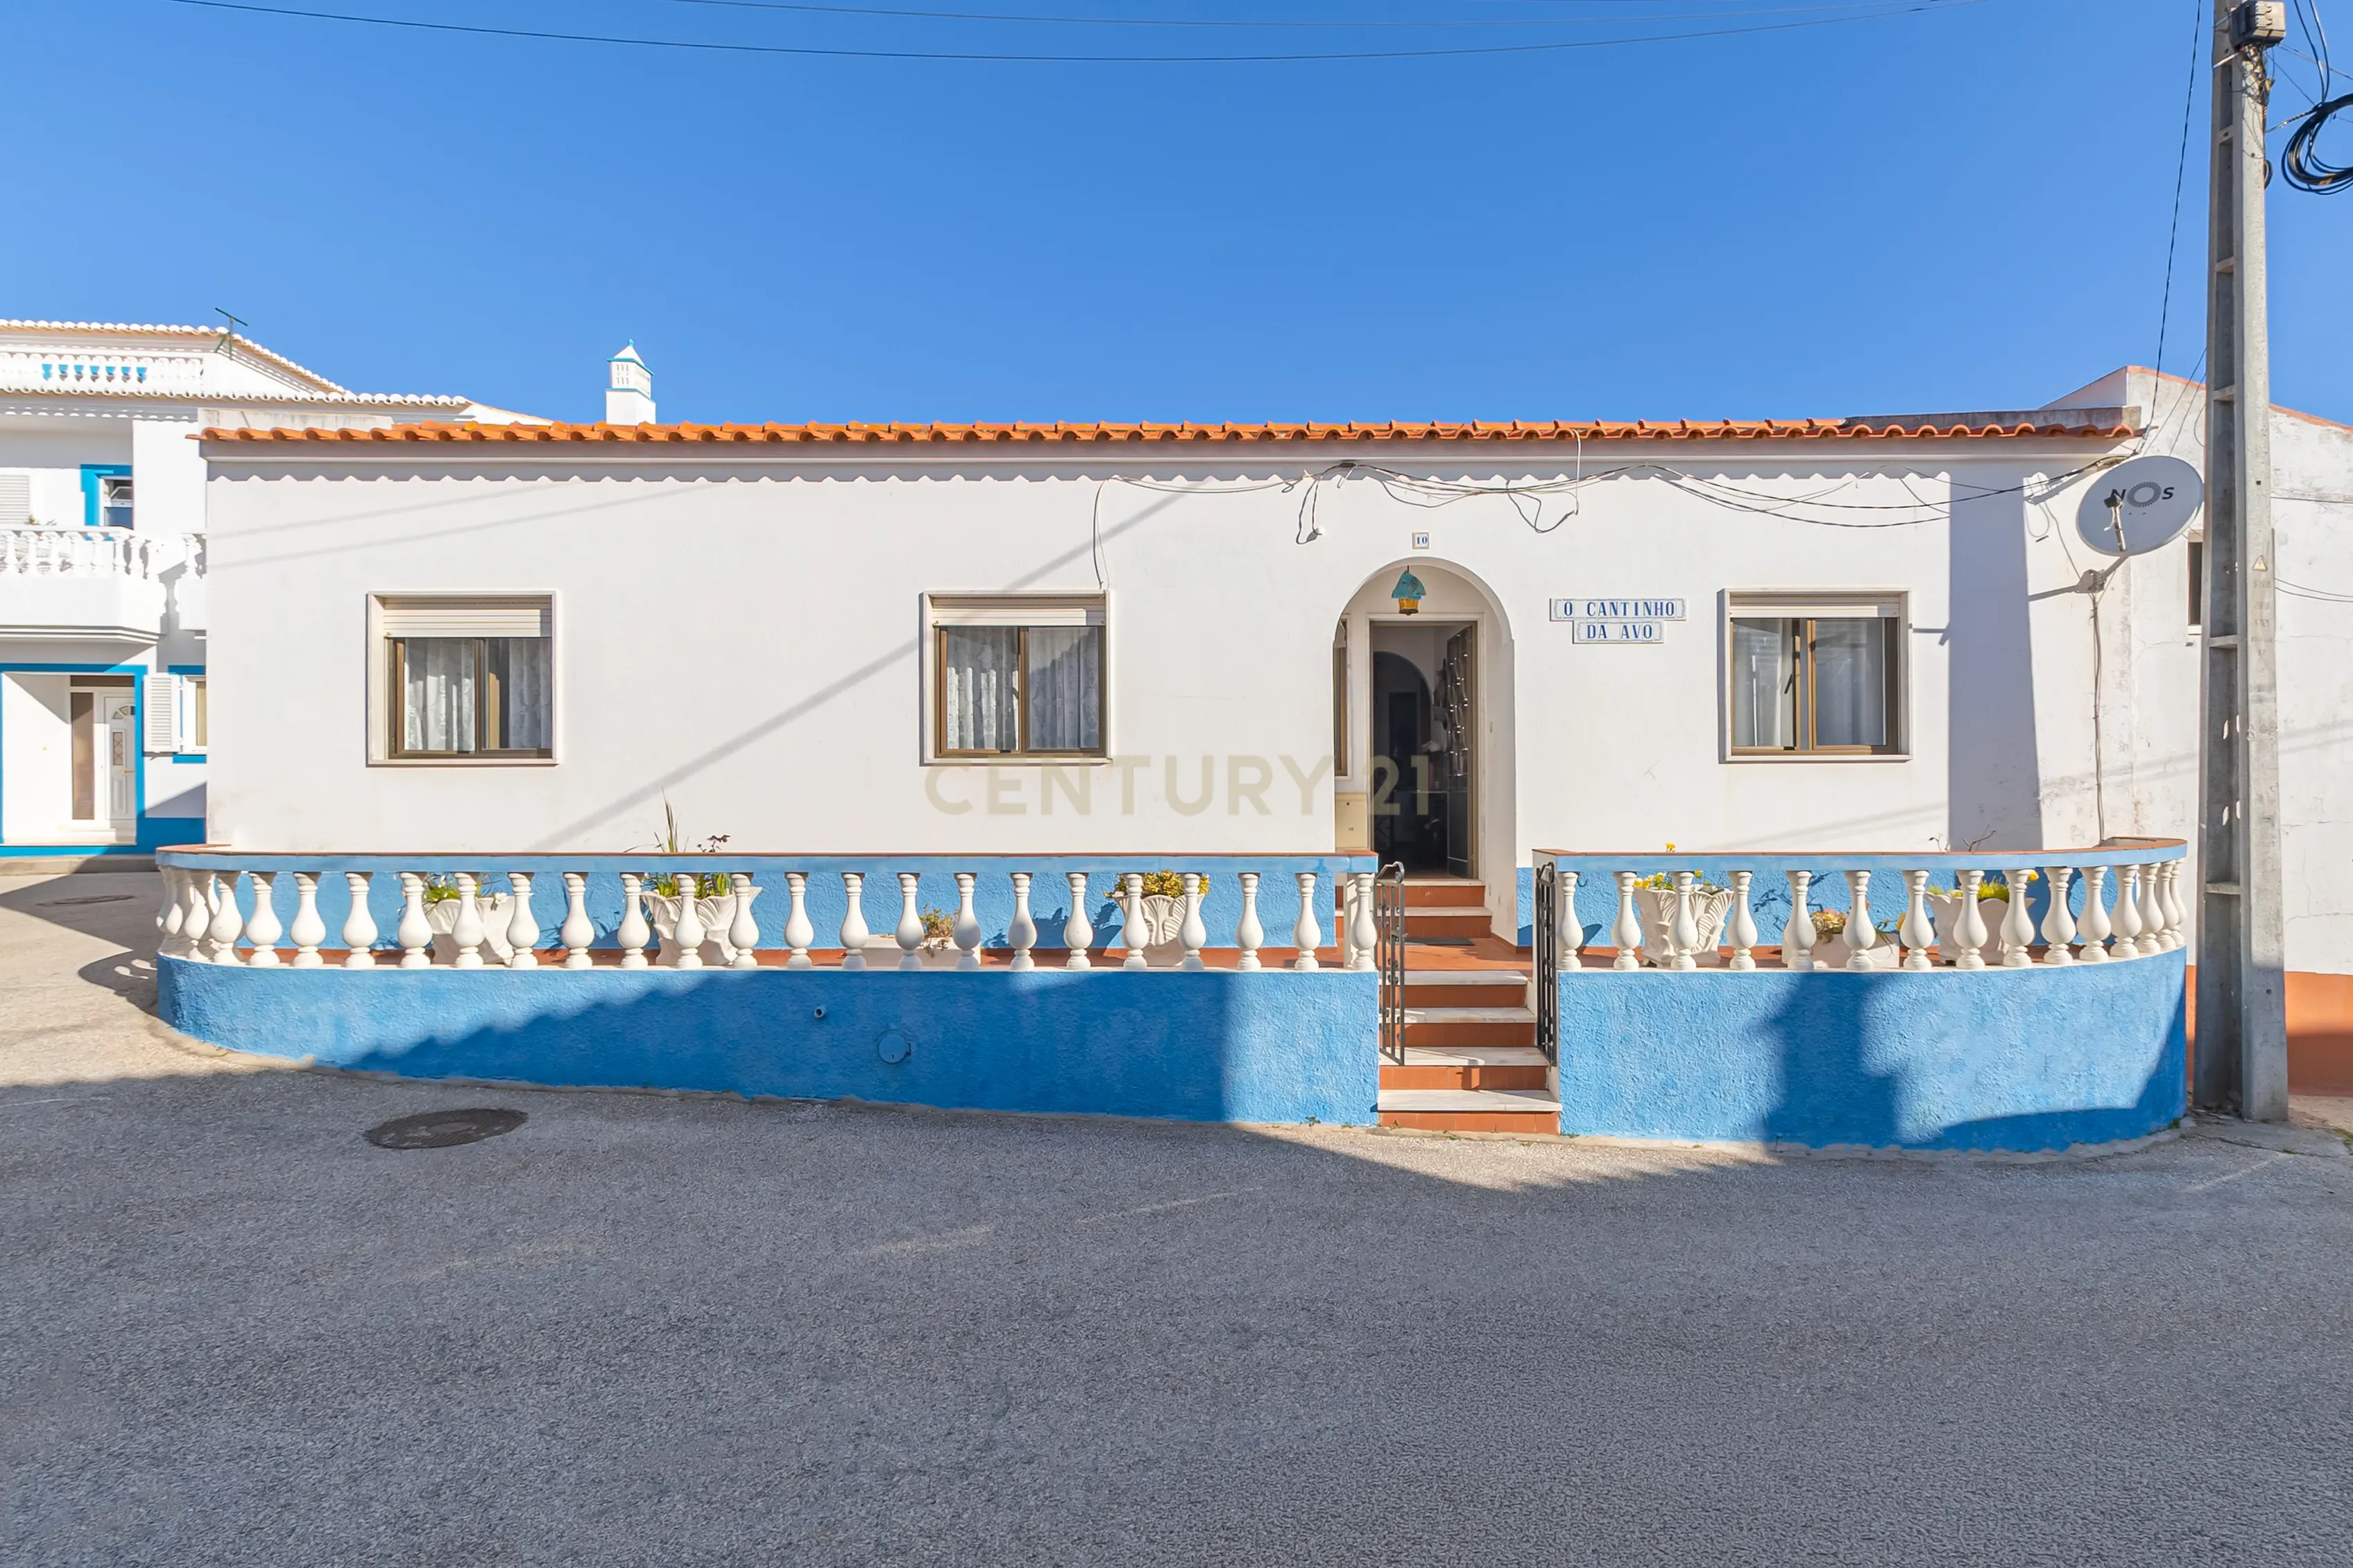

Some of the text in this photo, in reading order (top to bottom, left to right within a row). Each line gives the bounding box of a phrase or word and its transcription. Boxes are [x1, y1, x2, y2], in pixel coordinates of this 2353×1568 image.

[2109, 481, 2175, 508] NOS
[1417, 536, 1428, 544] 10
[1564, 601, 1675, 617] O CANTINHO
[1586, 624, 1652, 639] DA AVO
